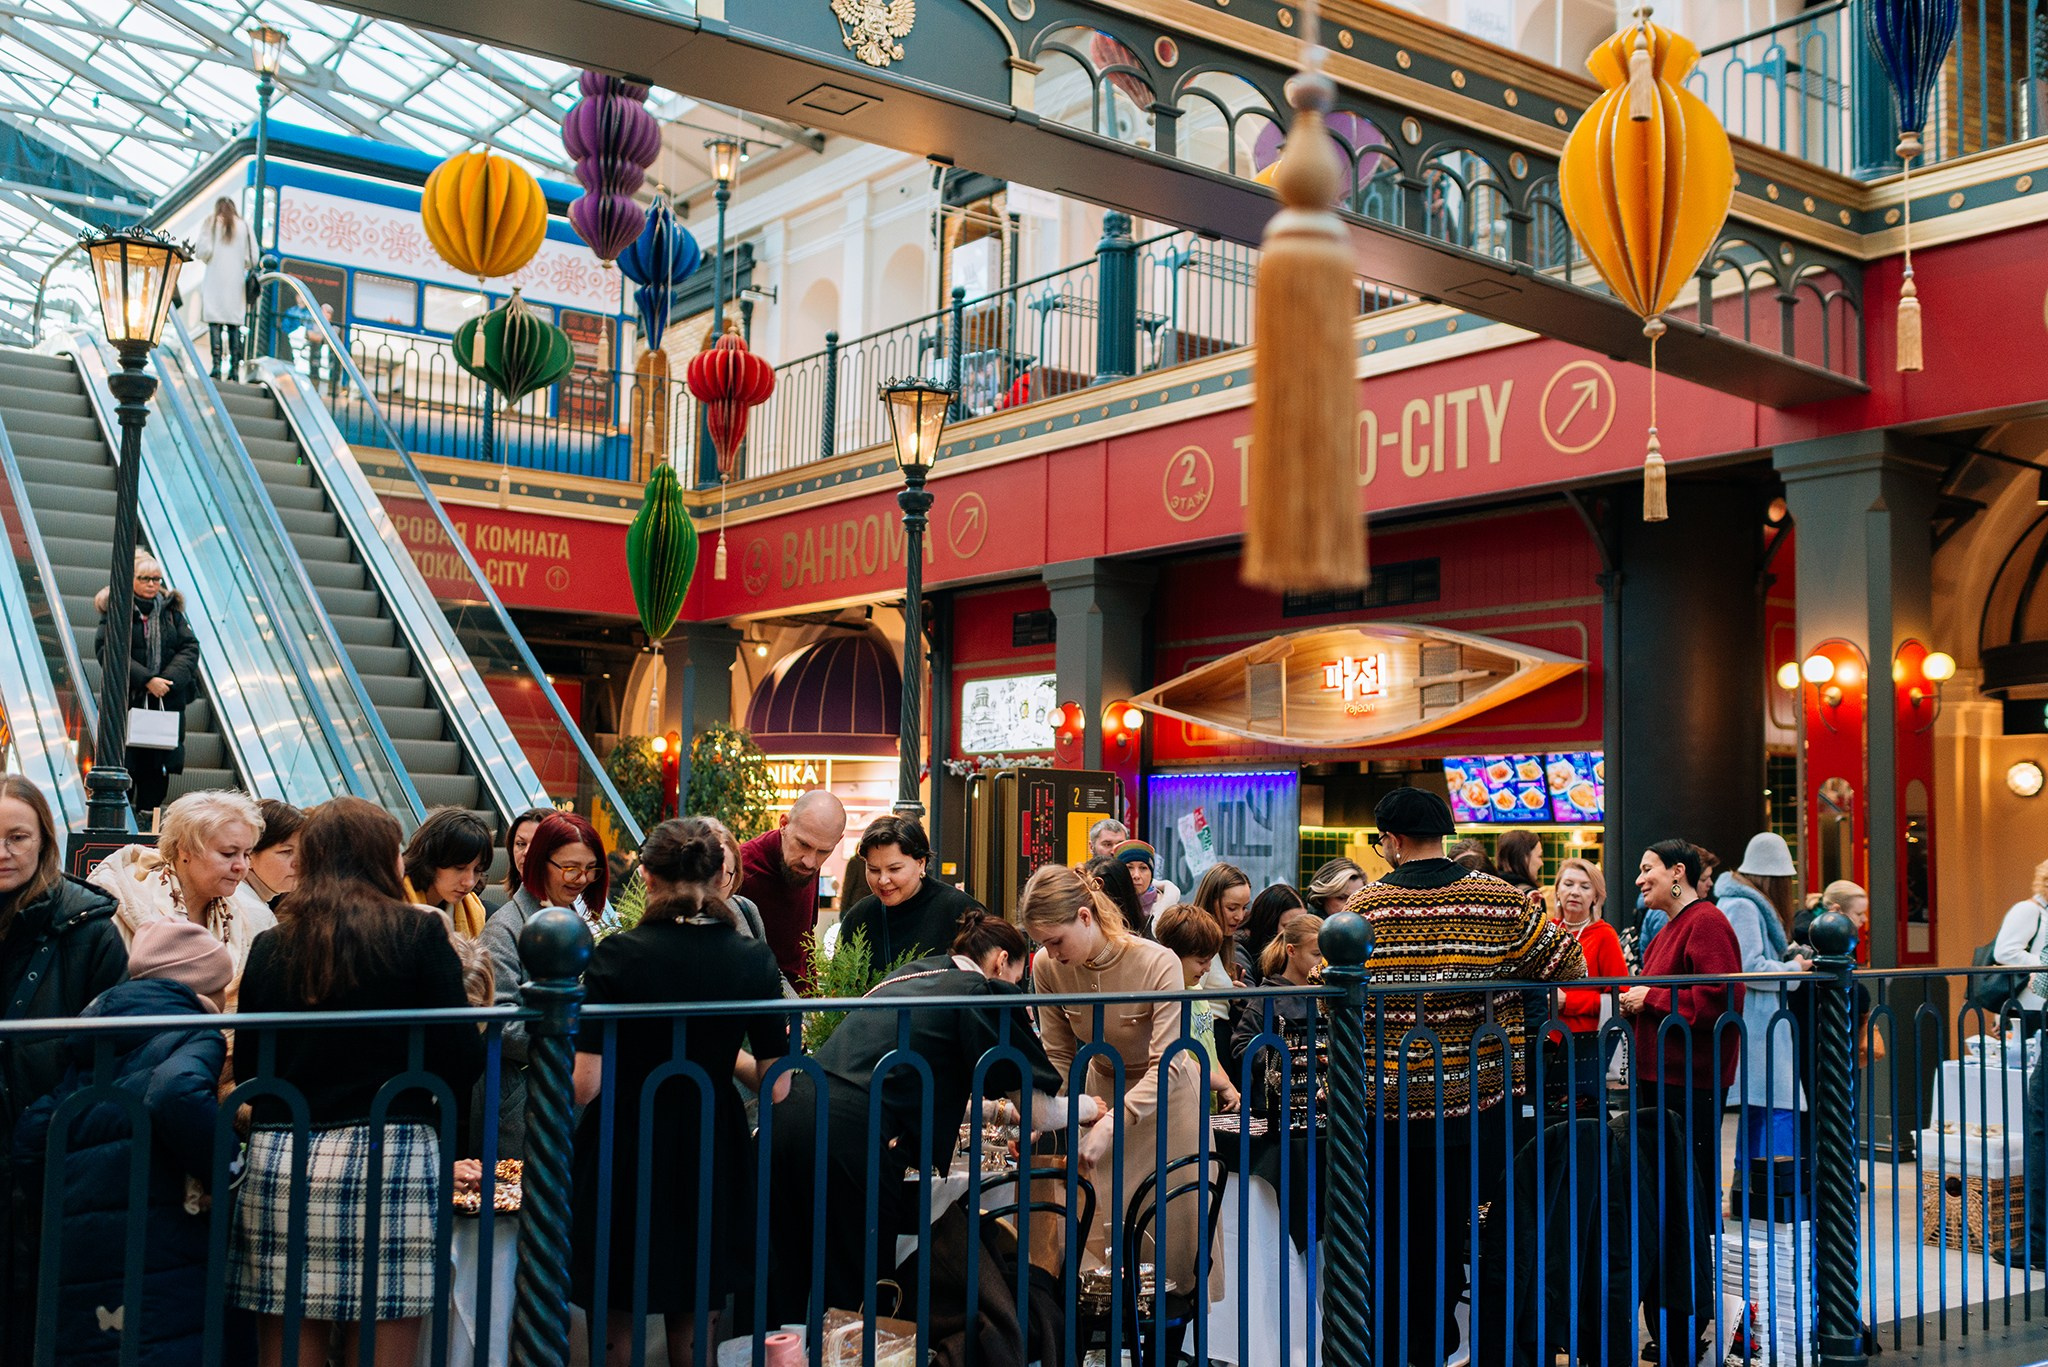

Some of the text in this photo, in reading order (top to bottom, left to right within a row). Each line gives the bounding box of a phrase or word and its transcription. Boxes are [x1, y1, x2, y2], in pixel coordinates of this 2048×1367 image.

[1233, 379, 1514, 507] TO-CITY
[1181, 453, 1197, 488] 2
[1170, 487, 1207, 511] ЭТАЖ
[475, 523, 571, 561] КОМНАТА
[781, 511, 934, 590] BAHROMA
[1321, 653, 1387, 702] 파전
[1344, 702, 1374, 716] Pajeon
[1073, 787, 1080, 806] 2
